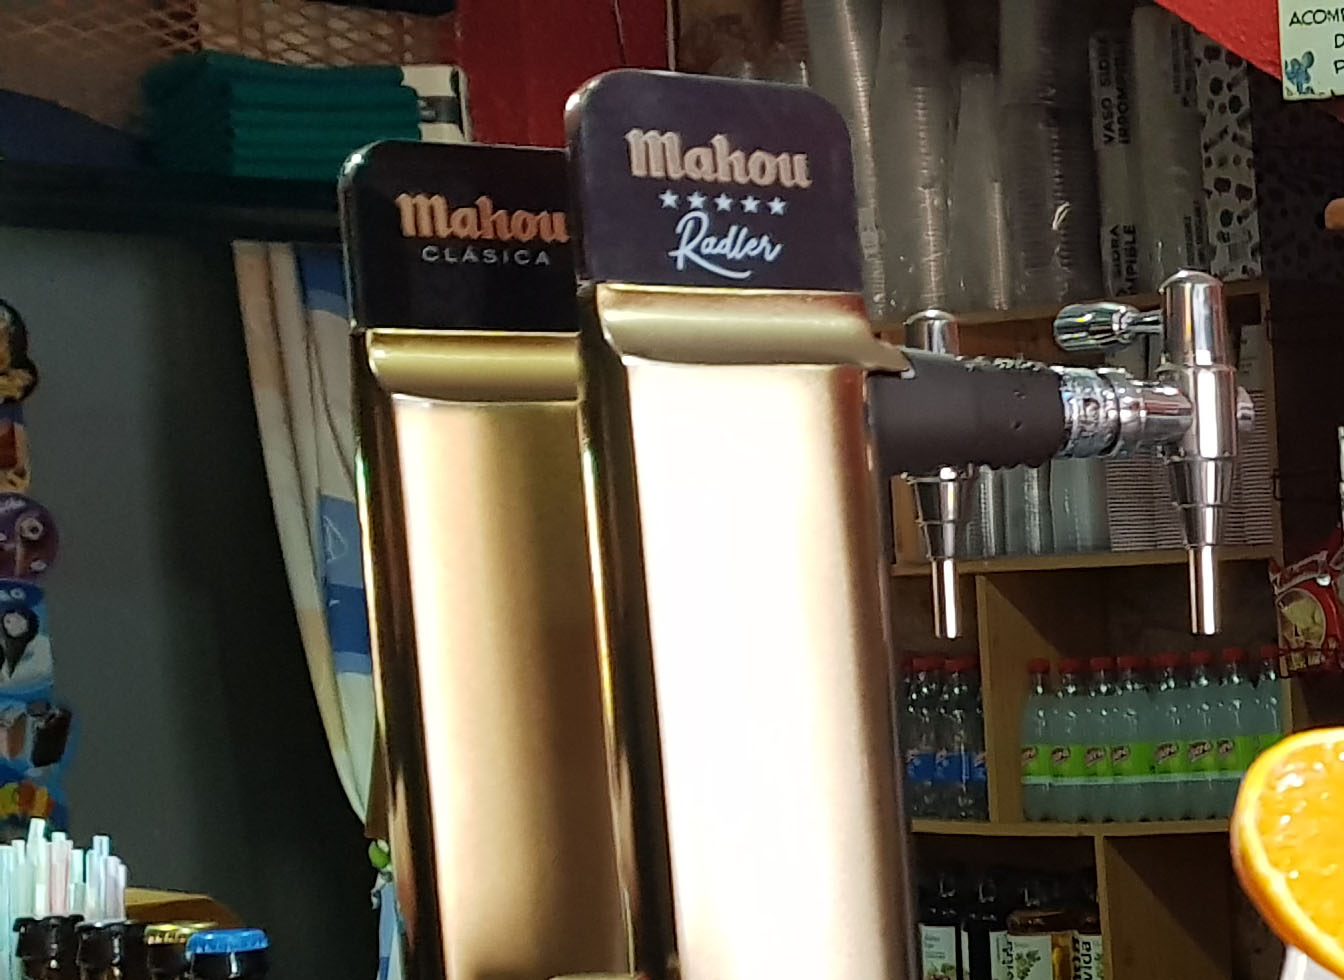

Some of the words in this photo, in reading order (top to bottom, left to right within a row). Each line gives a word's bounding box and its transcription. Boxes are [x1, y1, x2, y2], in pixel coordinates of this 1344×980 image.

[625, 127, 813, 188] Mahou
[396, 191, 572, 243] Mahou
[668, 210, 785, 279] Radler
